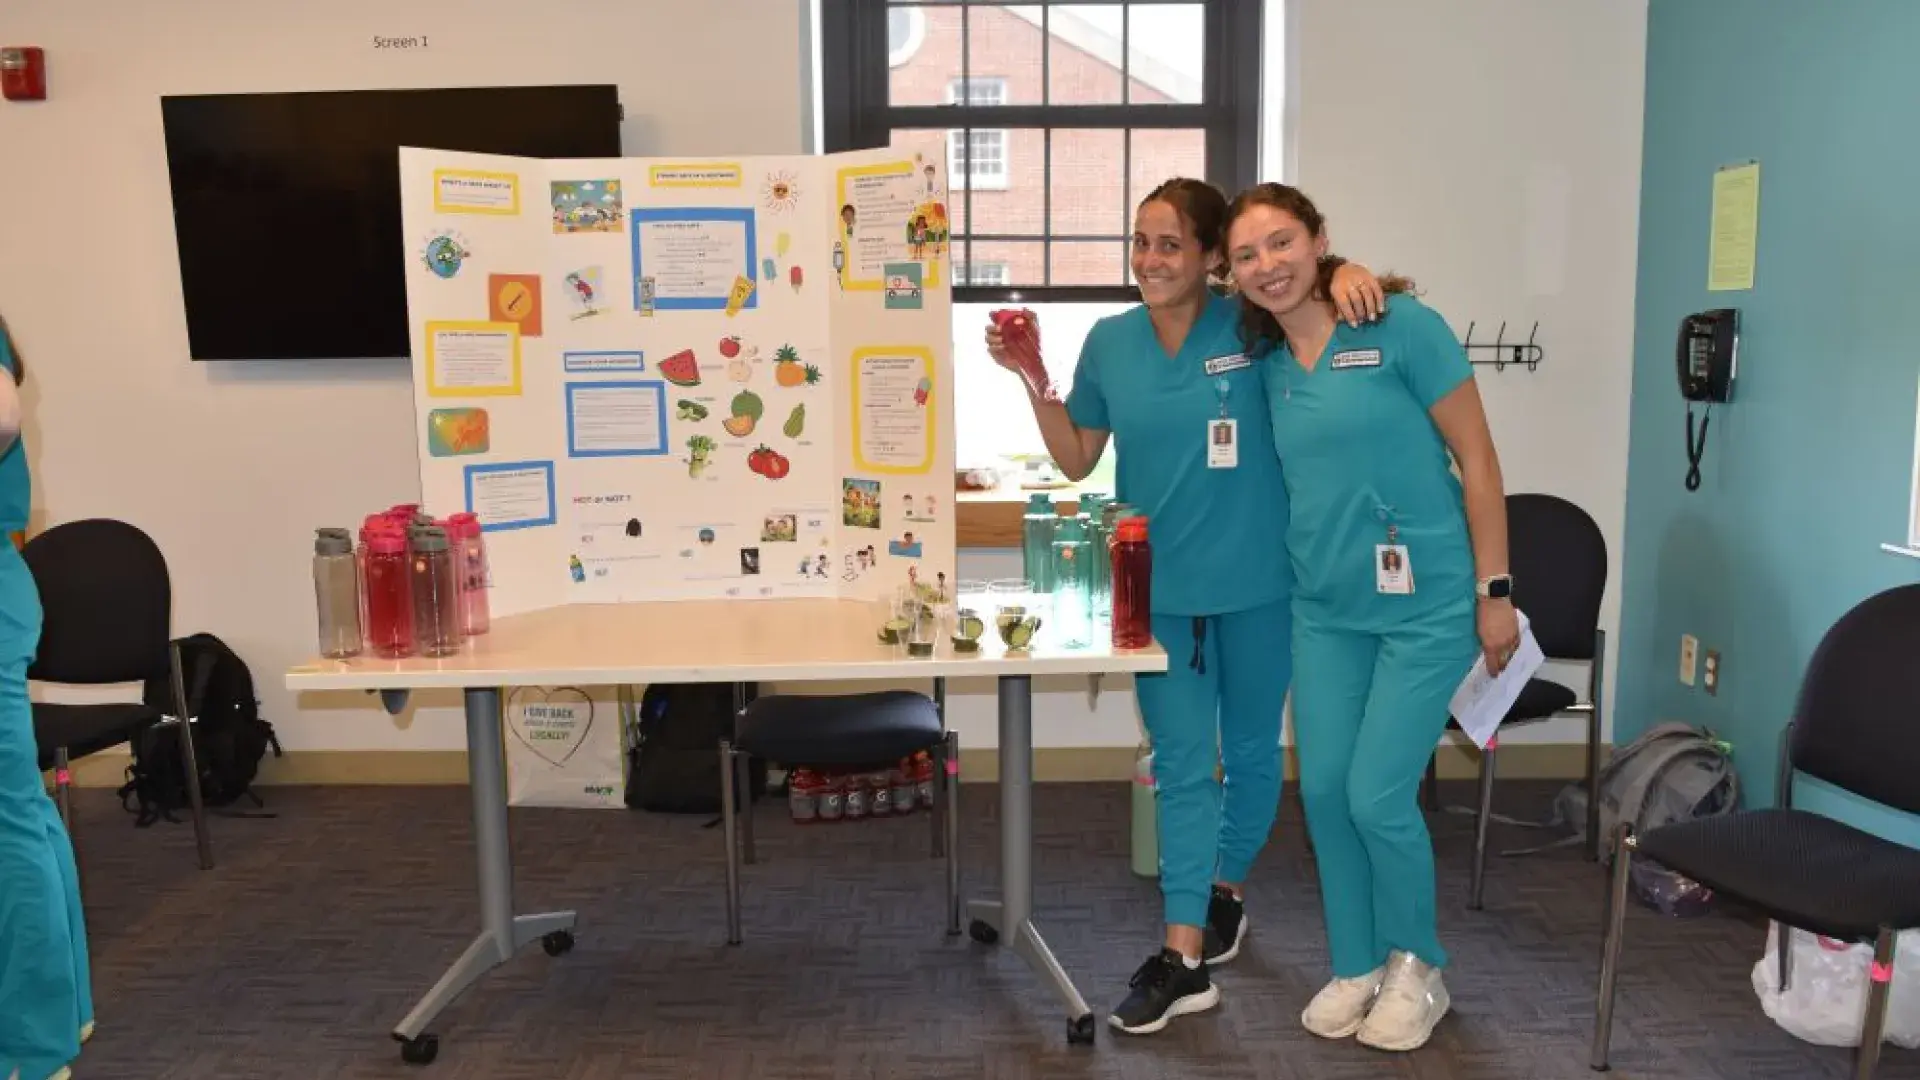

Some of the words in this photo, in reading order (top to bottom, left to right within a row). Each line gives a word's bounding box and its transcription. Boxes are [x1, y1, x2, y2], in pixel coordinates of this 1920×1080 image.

[373, 35, 418, 49] Screen
[420, 36, 427, 47] 1
[573, 496, 592, 504] HOT
[605, 494, 625, 504] NOT
[550, 707, 575, 719] BACK
